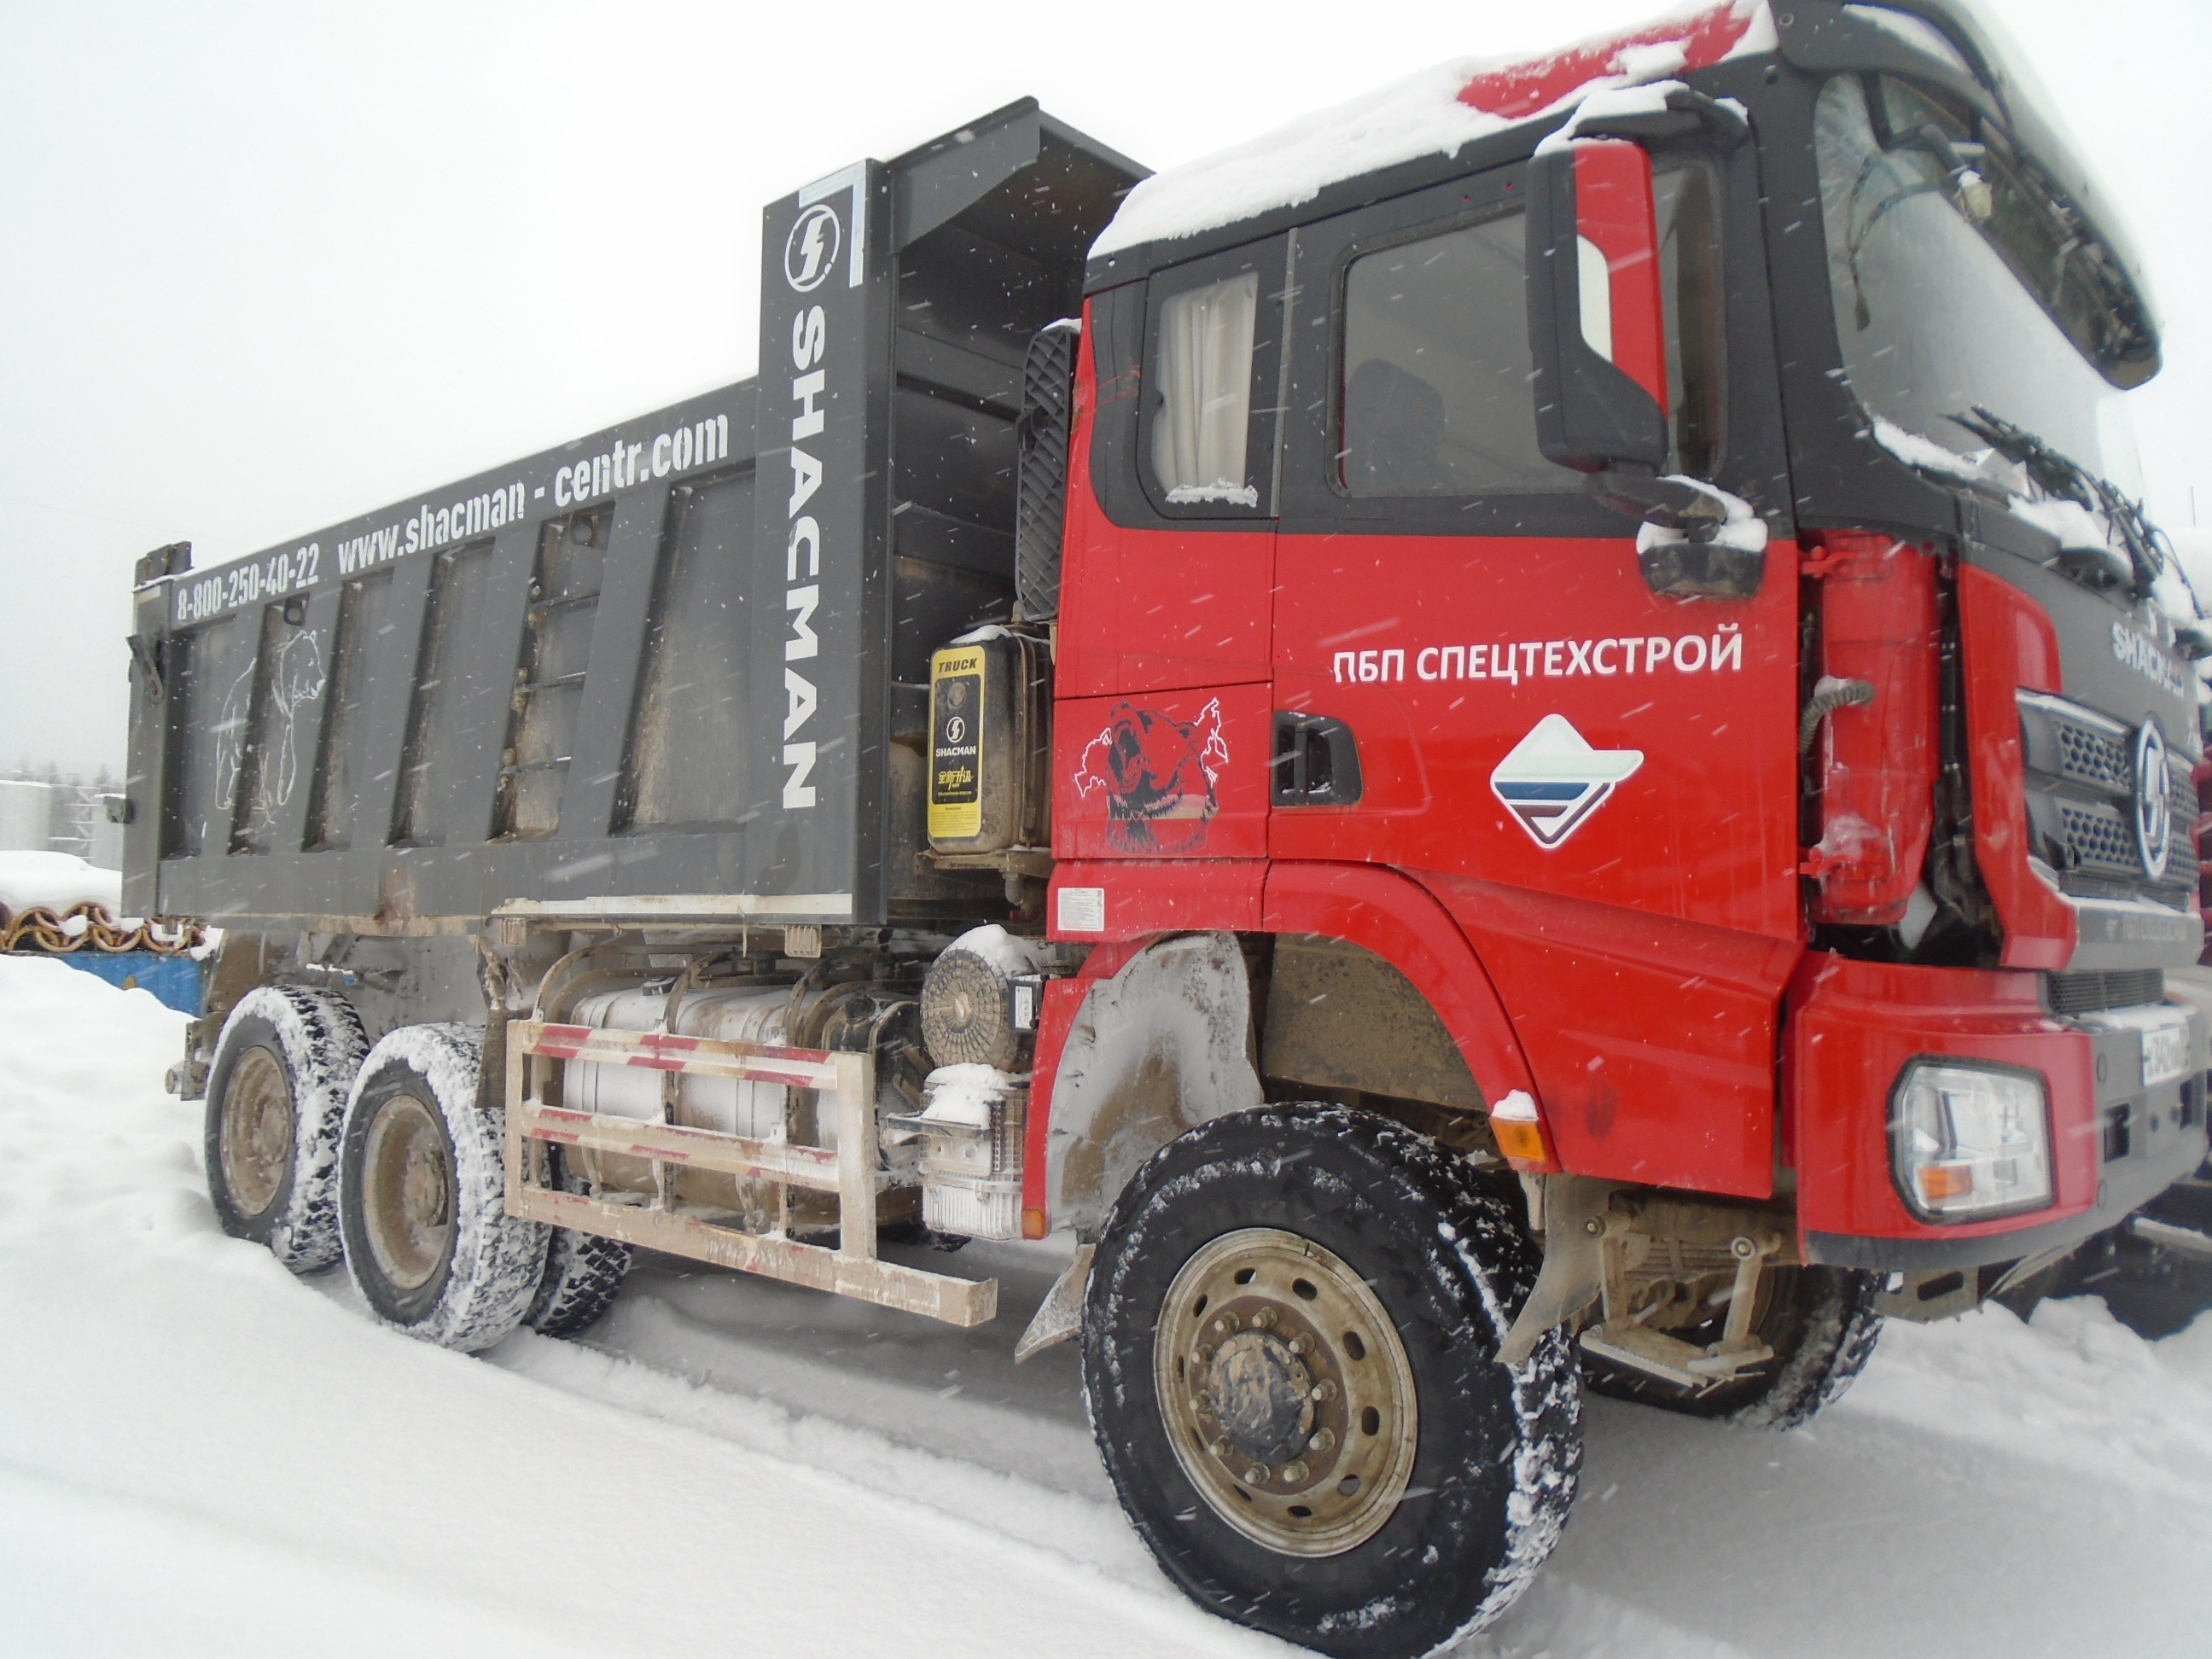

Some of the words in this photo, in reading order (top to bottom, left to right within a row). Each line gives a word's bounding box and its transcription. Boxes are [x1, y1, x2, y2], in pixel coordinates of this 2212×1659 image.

[178, 542, 319, 620] 8-800-250-40-22
[338, 480, 526, 574] www.shacman
[555, 414, 729, 508] centr.com
[783, 304, 825, 809] SHACMAN
[939, 657, 978, 673] TRUCK
[1333, 649, 1405, 683] ПБП
[1417, 622, 1743, 685] СПЕЦТЕХСТРОЙ
[935, 745, 976, 758] SHACMAN
